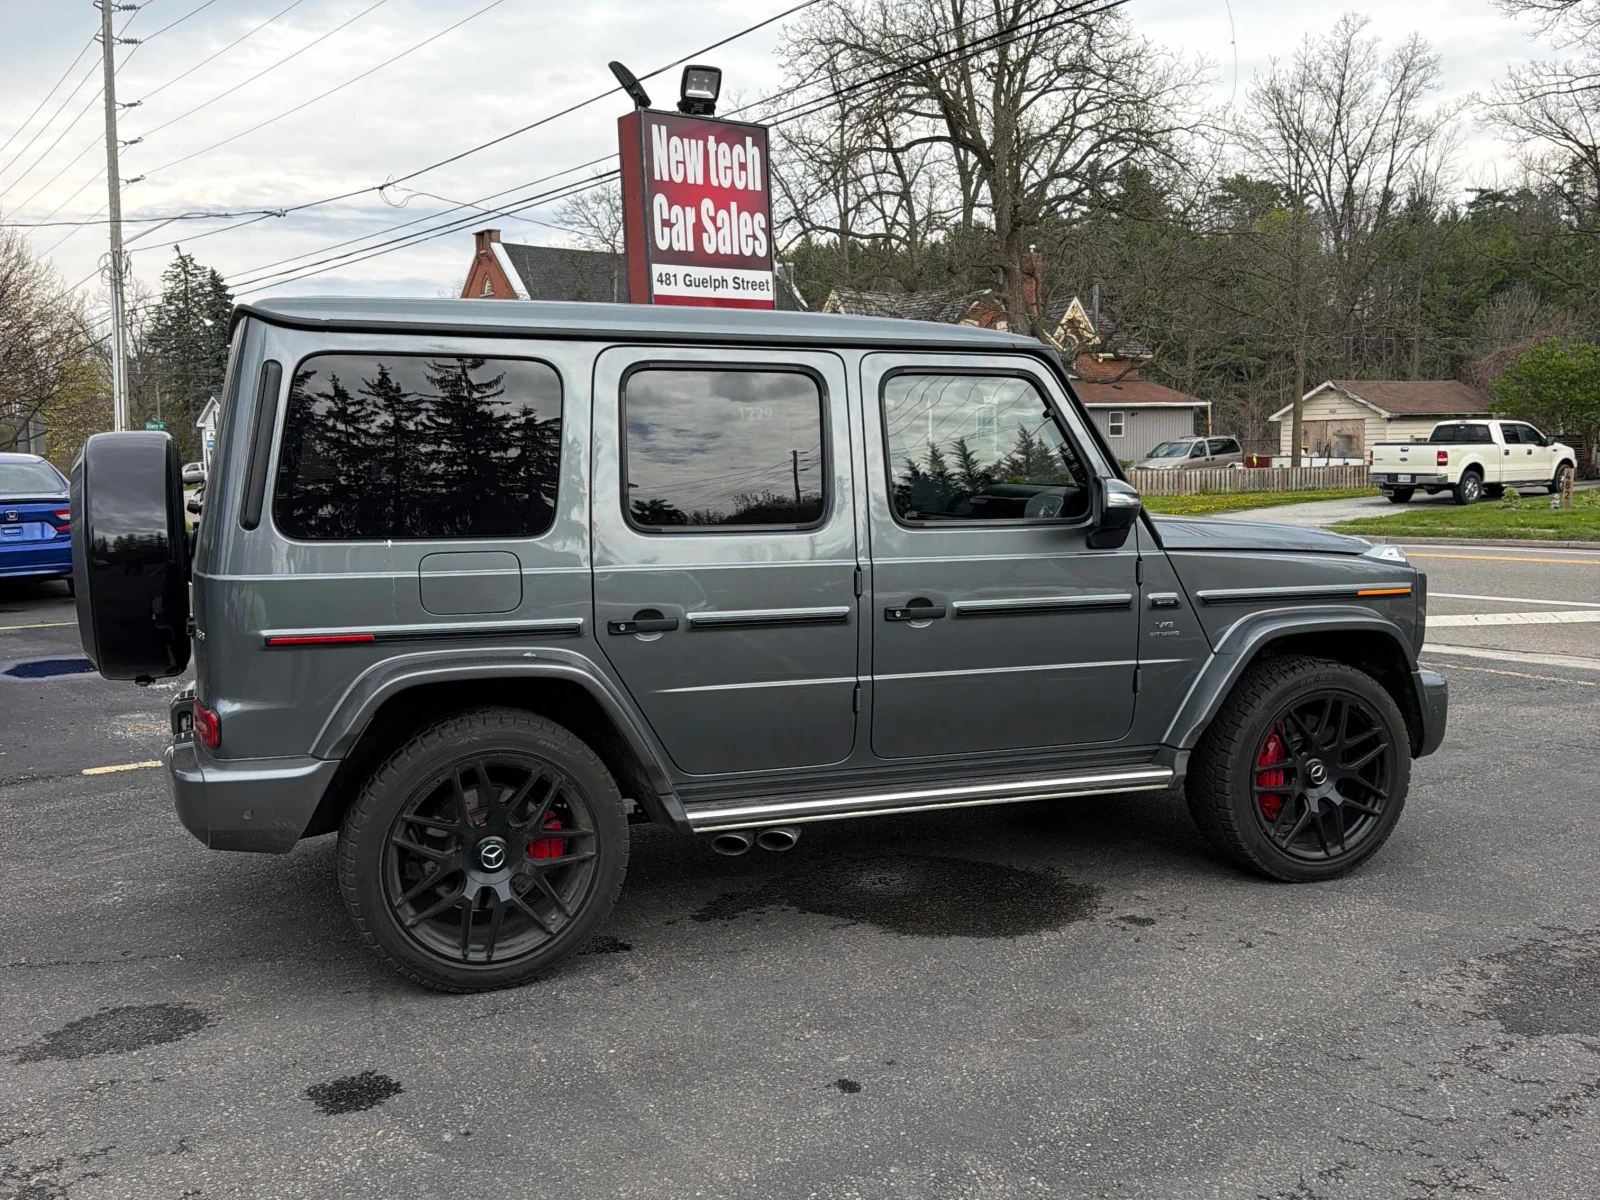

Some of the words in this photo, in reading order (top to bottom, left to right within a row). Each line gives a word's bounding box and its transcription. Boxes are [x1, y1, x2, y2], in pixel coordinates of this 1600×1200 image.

[651, 123, 704, 185] New
[707, 134, 762, 191] tech
[653, 193, 696, 252] Car
[700, 197, 767, 258] Sales
[656, 272, 678, 287] 481
[683, 273, 729, 292] Guelph
[732, 276, 770, 292] Street
